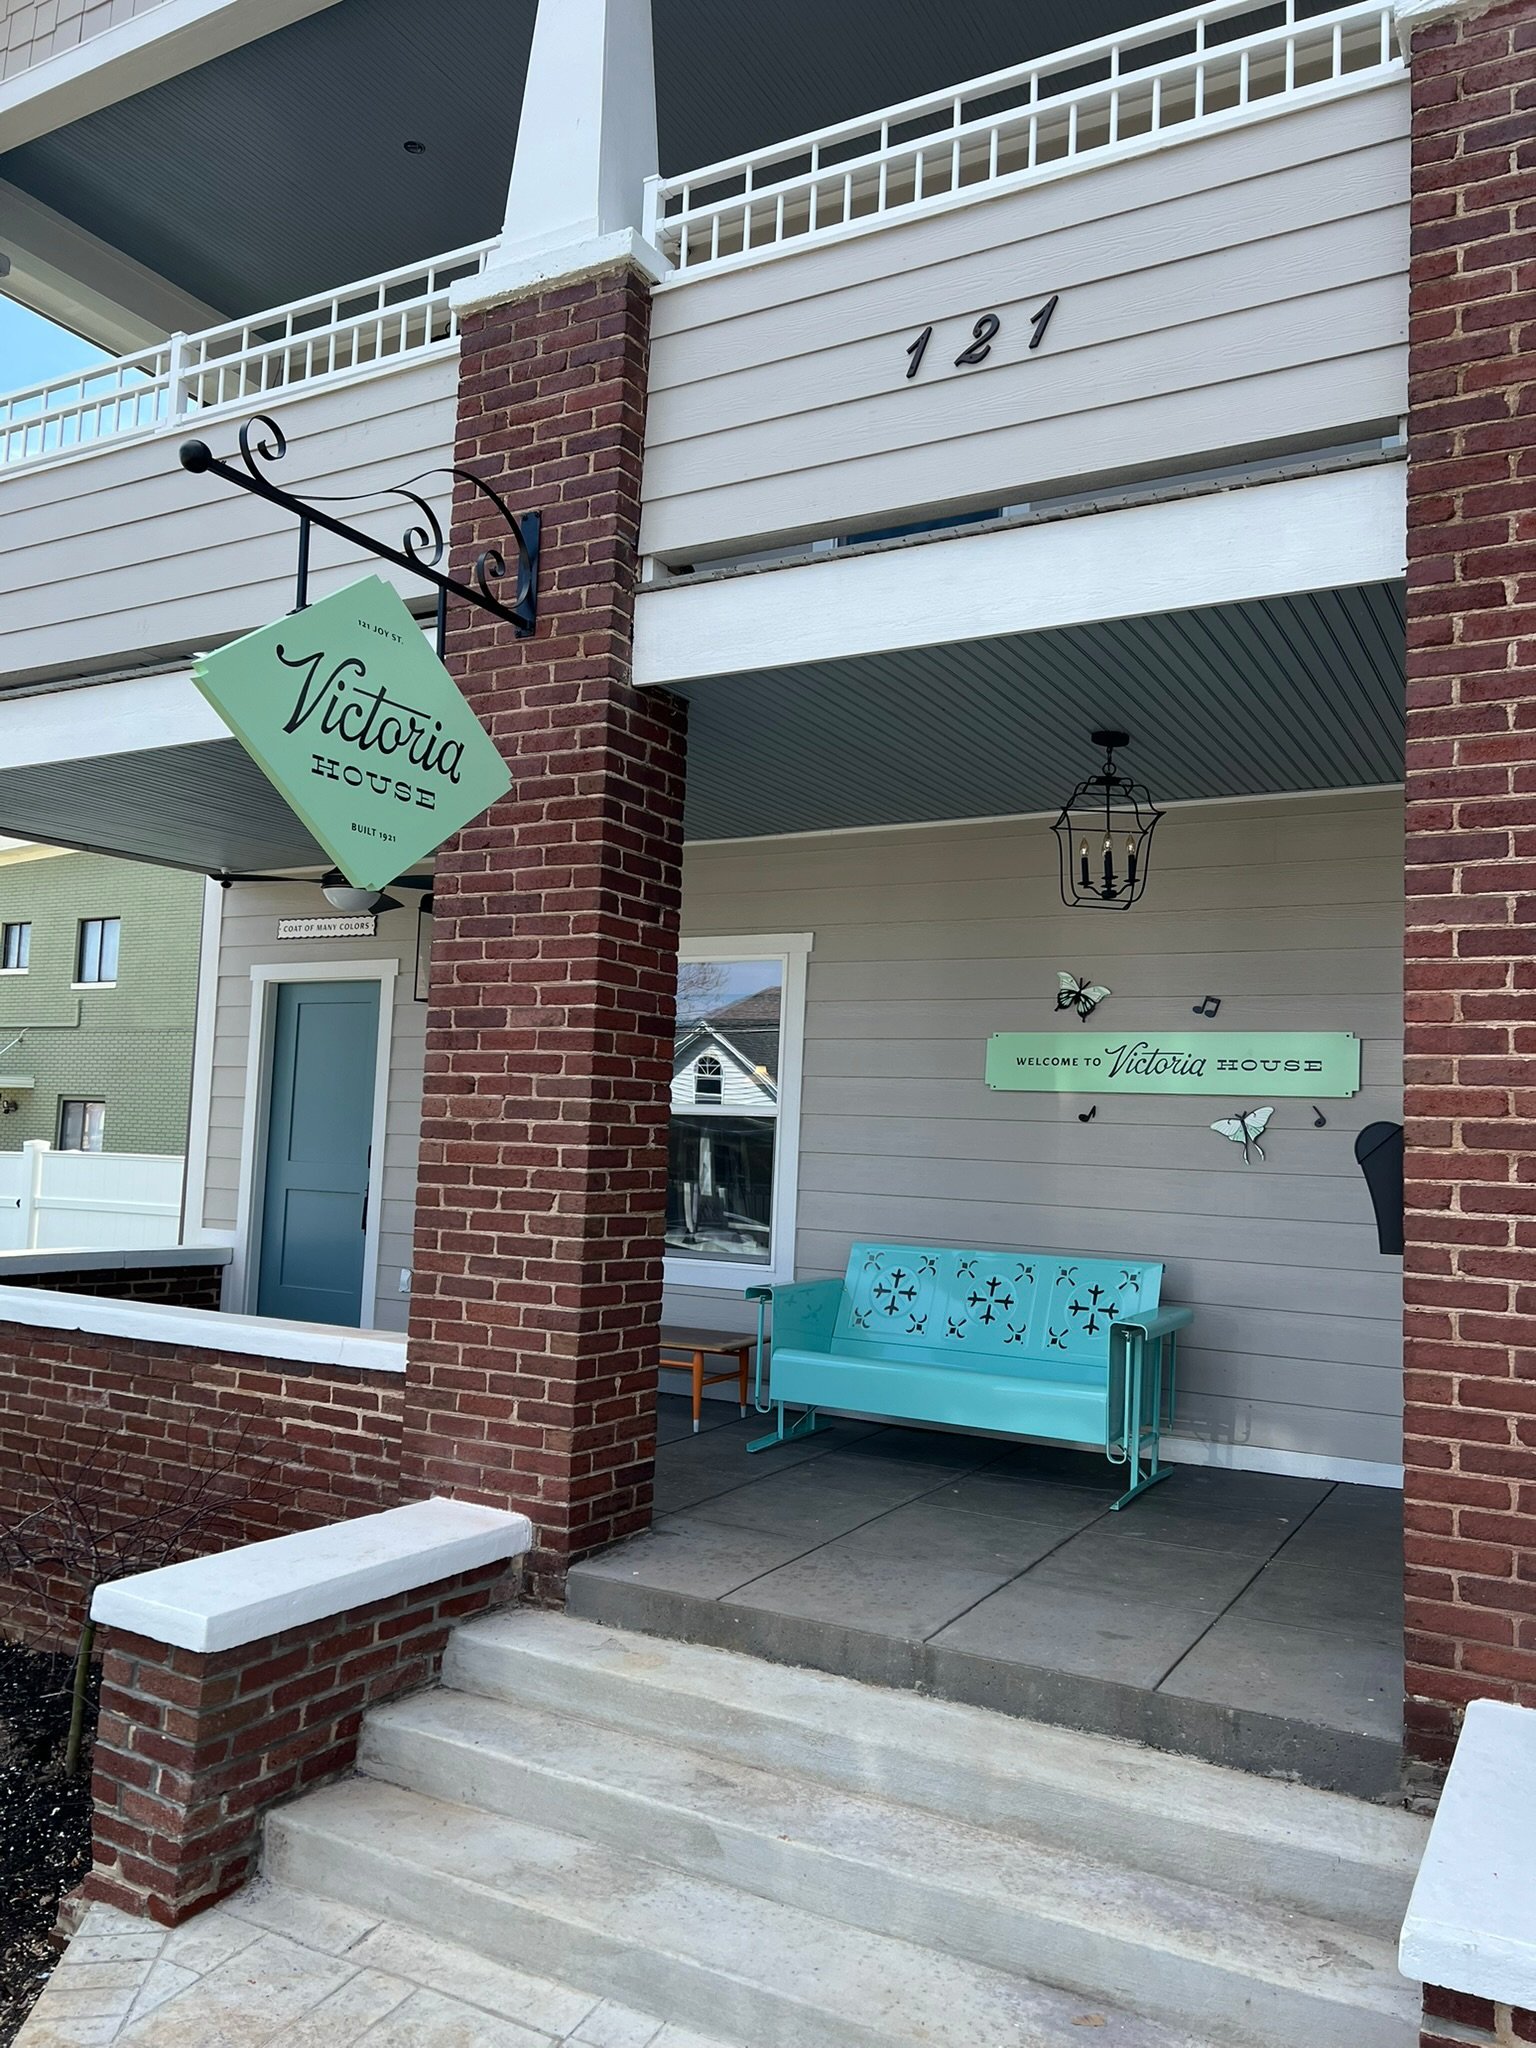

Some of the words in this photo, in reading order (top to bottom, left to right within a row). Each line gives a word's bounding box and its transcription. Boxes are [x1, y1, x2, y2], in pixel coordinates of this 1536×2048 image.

[906, 295, 1059, 379] 121
[358, 619, 370, 630] 121
[373, 625, 390, 638] JOY
[391, 633, 404, 645] ST.
[276, 643, 465, 784] Victoria
[311, 753, 437, 811] HOUSE
[351, 822, 377, 837] BUILT
[379, 832, 396, 843] 1921
[283, 925, 303, 933] COAT
[304, 924, 315, 932] OF
[316, 924, 337, 932] MANY
[1016, 1056, 1079, 1067] WELCOME
[1084, 1057, 1102, 1067] TO
[1105, 1041, 1207, 1078] Victoria
[1216, 1059, 1323, 1072] HOUSE
